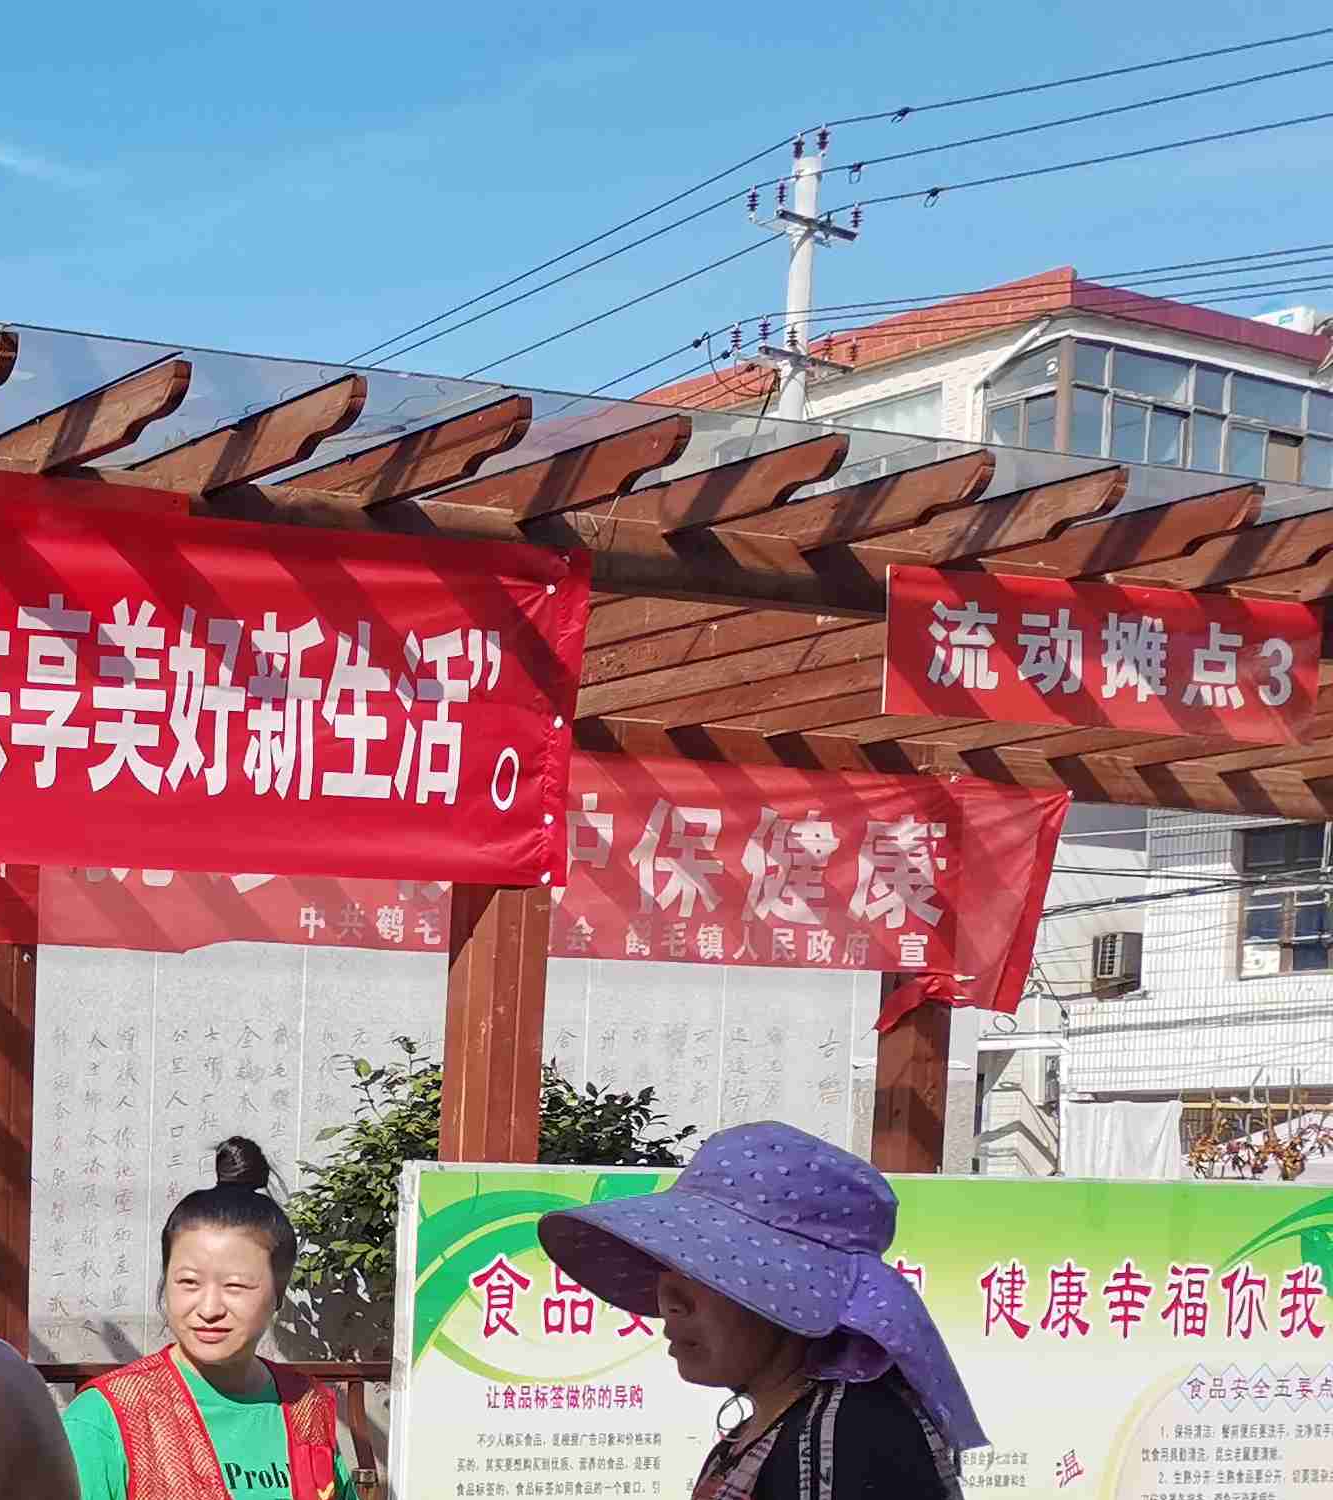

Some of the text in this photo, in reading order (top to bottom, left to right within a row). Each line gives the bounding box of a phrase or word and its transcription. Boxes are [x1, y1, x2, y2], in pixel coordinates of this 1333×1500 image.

[897, 930, 929, 969] 宣
[486, 1384, 644, 1410] 让食品标签做你的导购
[1187, 1376, 1333, 1400] 食品安全五要点
[224, 1462, 290, 1490] Prob
